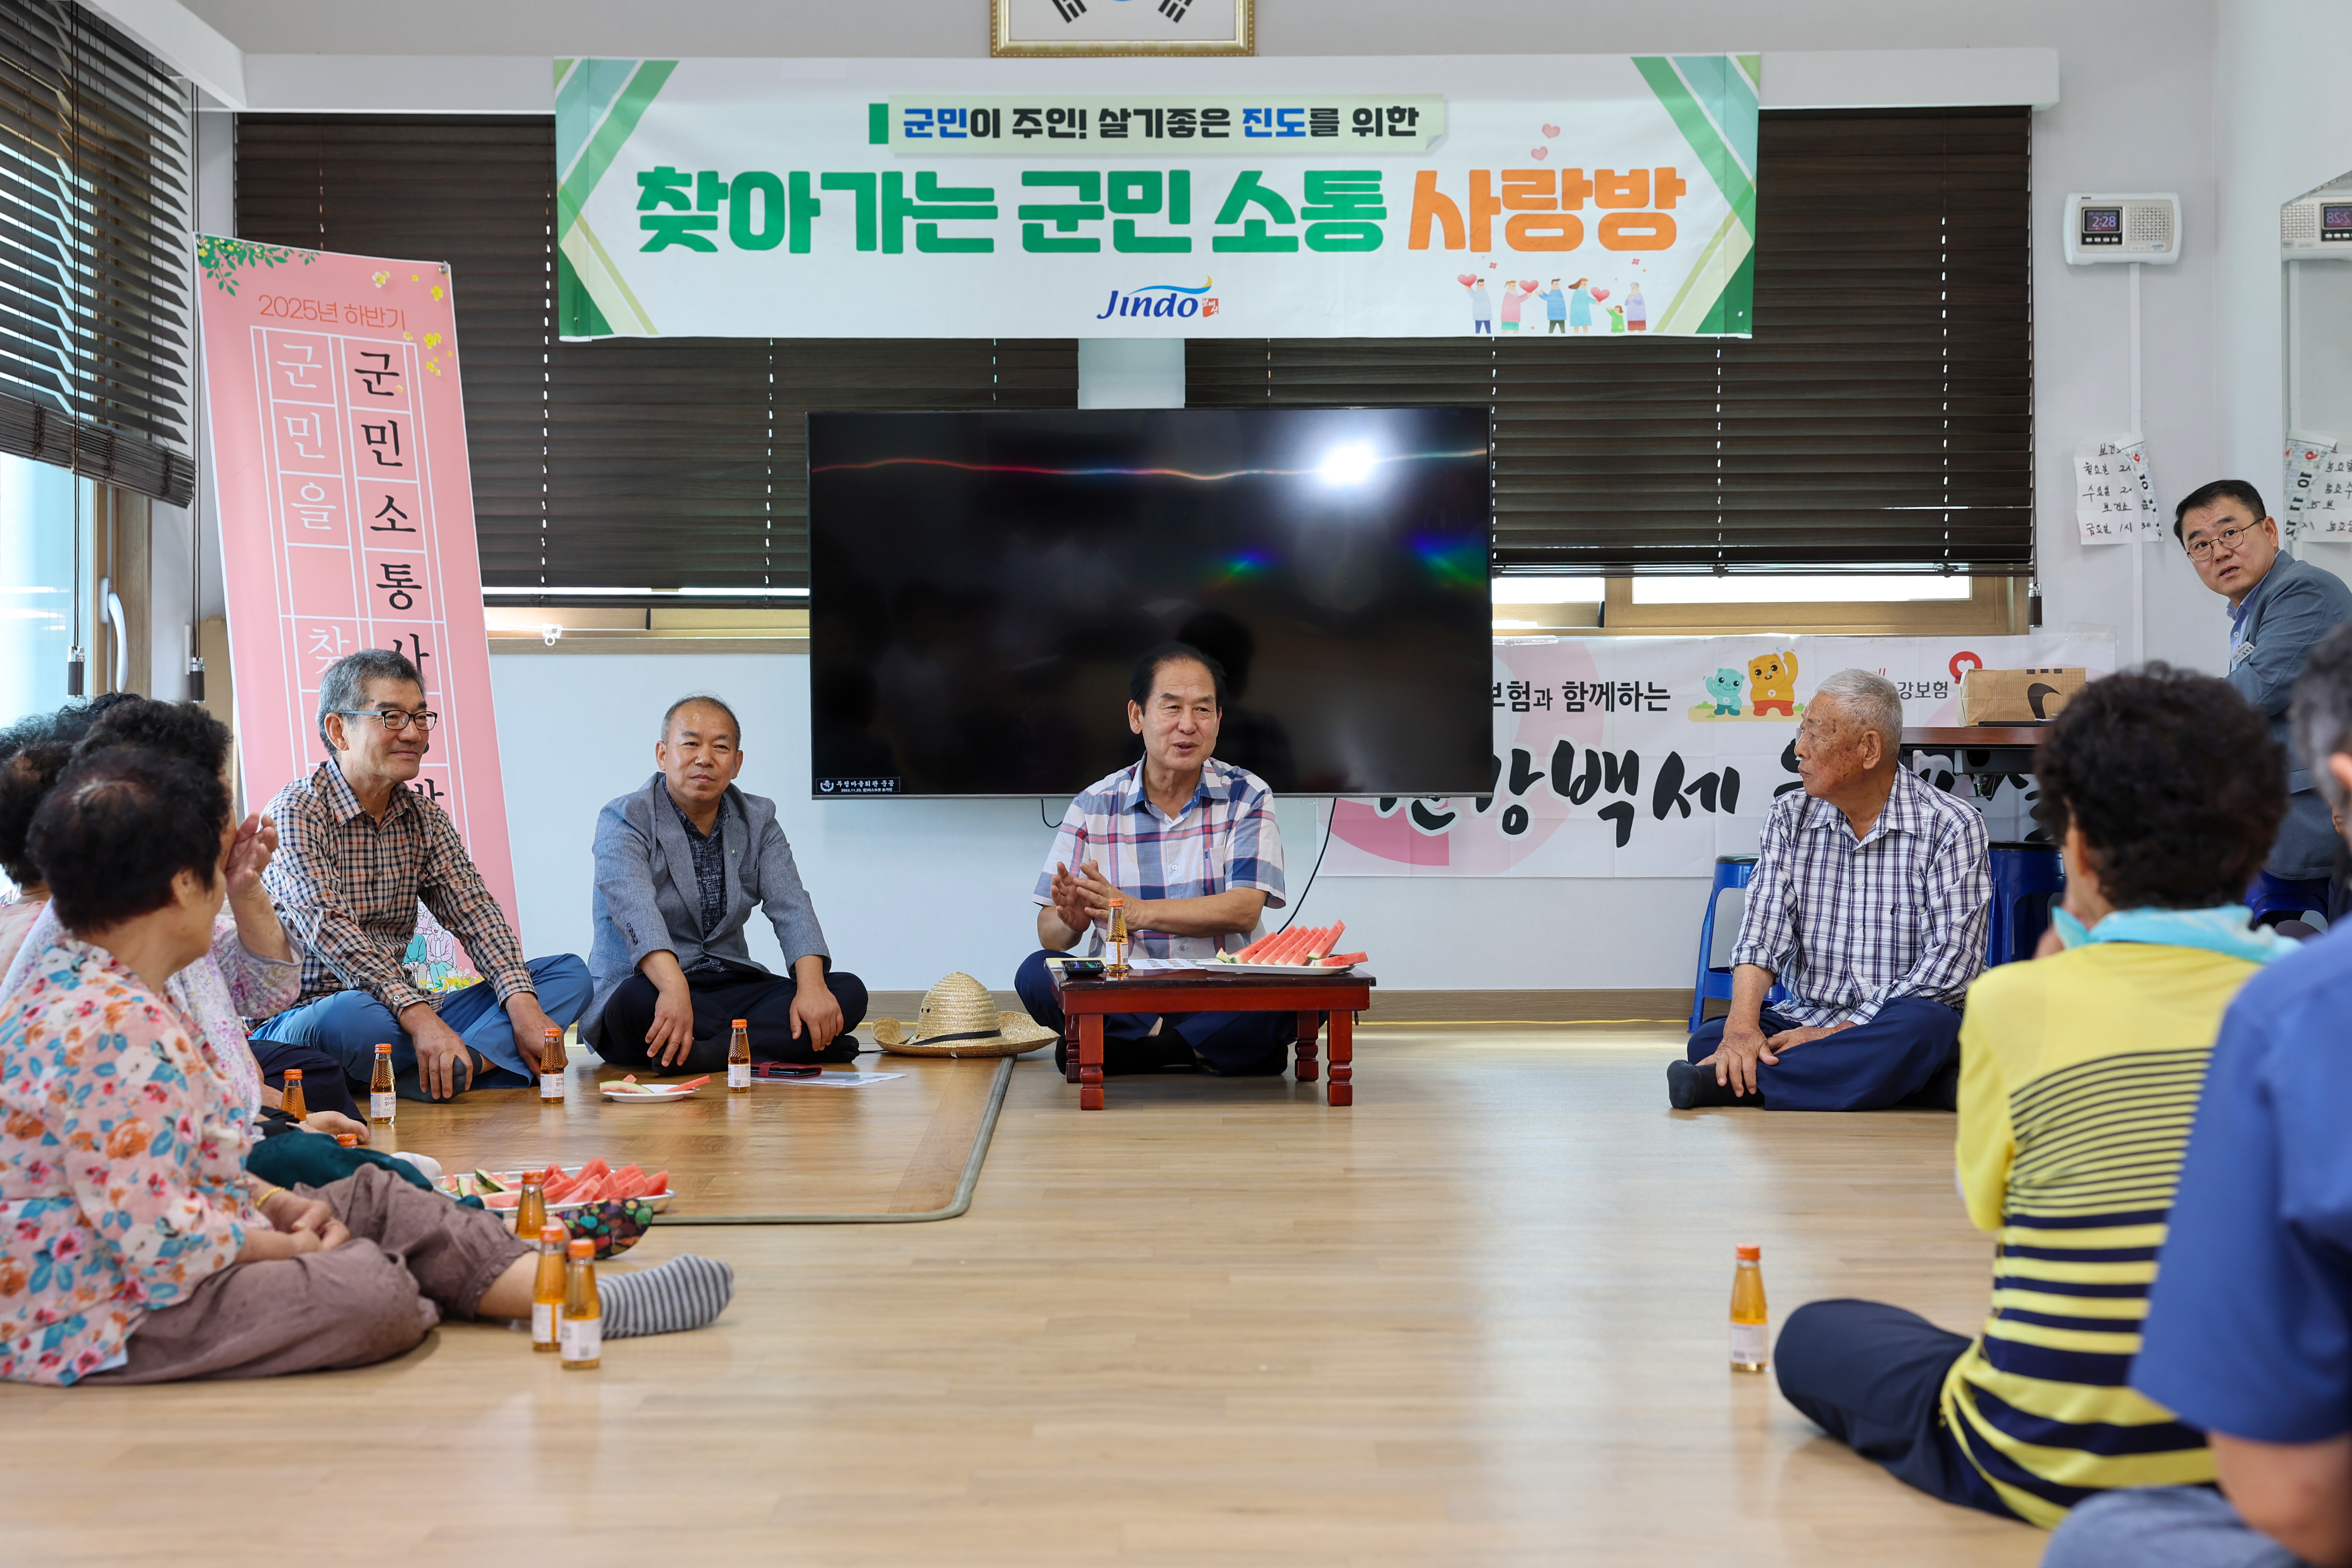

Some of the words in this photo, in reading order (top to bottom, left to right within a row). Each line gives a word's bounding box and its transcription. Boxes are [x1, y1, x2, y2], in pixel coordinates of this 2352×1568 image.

[904, 108, 1001, 139] 군민이
[1013, 108, 1087, 140] 주인!
[1099, 108, 1231, 139] 살기좋은
[1243, 108, 1340, 138] 진도를
[1352, 106, 1420, 138] 위한
[637, 166, 998, 254] 찾아가는
[1018, 169, 1192, 253] 군민
[1212, 170, 1387, 253] 소통
[1408, 167, 1686, 252] 사랑방
[2092, 216, 2116, 227] 2:28
[259, 295, 338, 323] 2025년
[344, 304, 405, 330] 하반기
[1096, 290, 1198, 319] Jindo
[276, 343, 337, 530] 군민을
[2082, 485, 2111, 502] 수요일
[1562, 681, 1670, 712] 함께하는
